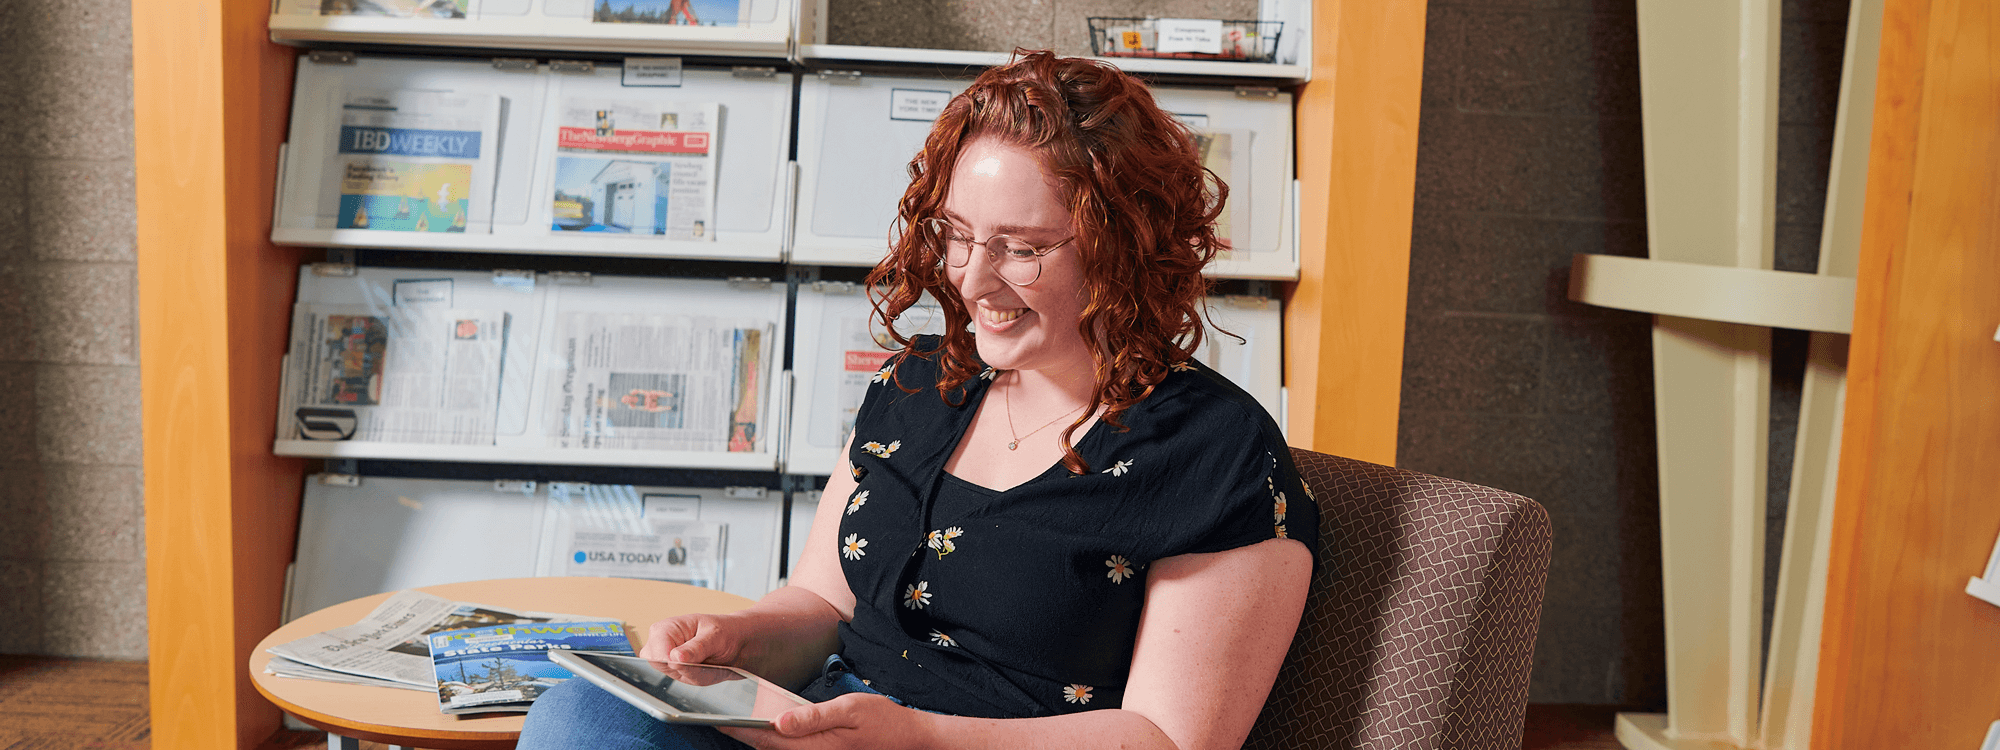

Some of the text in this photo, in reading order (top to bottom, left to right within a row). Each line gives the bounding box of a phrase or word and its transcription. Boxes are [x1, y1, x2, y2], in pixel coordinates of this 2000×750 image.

[588, 551, 663, 564] USA TODAY
[443, 643, 572, 658] State Parks
